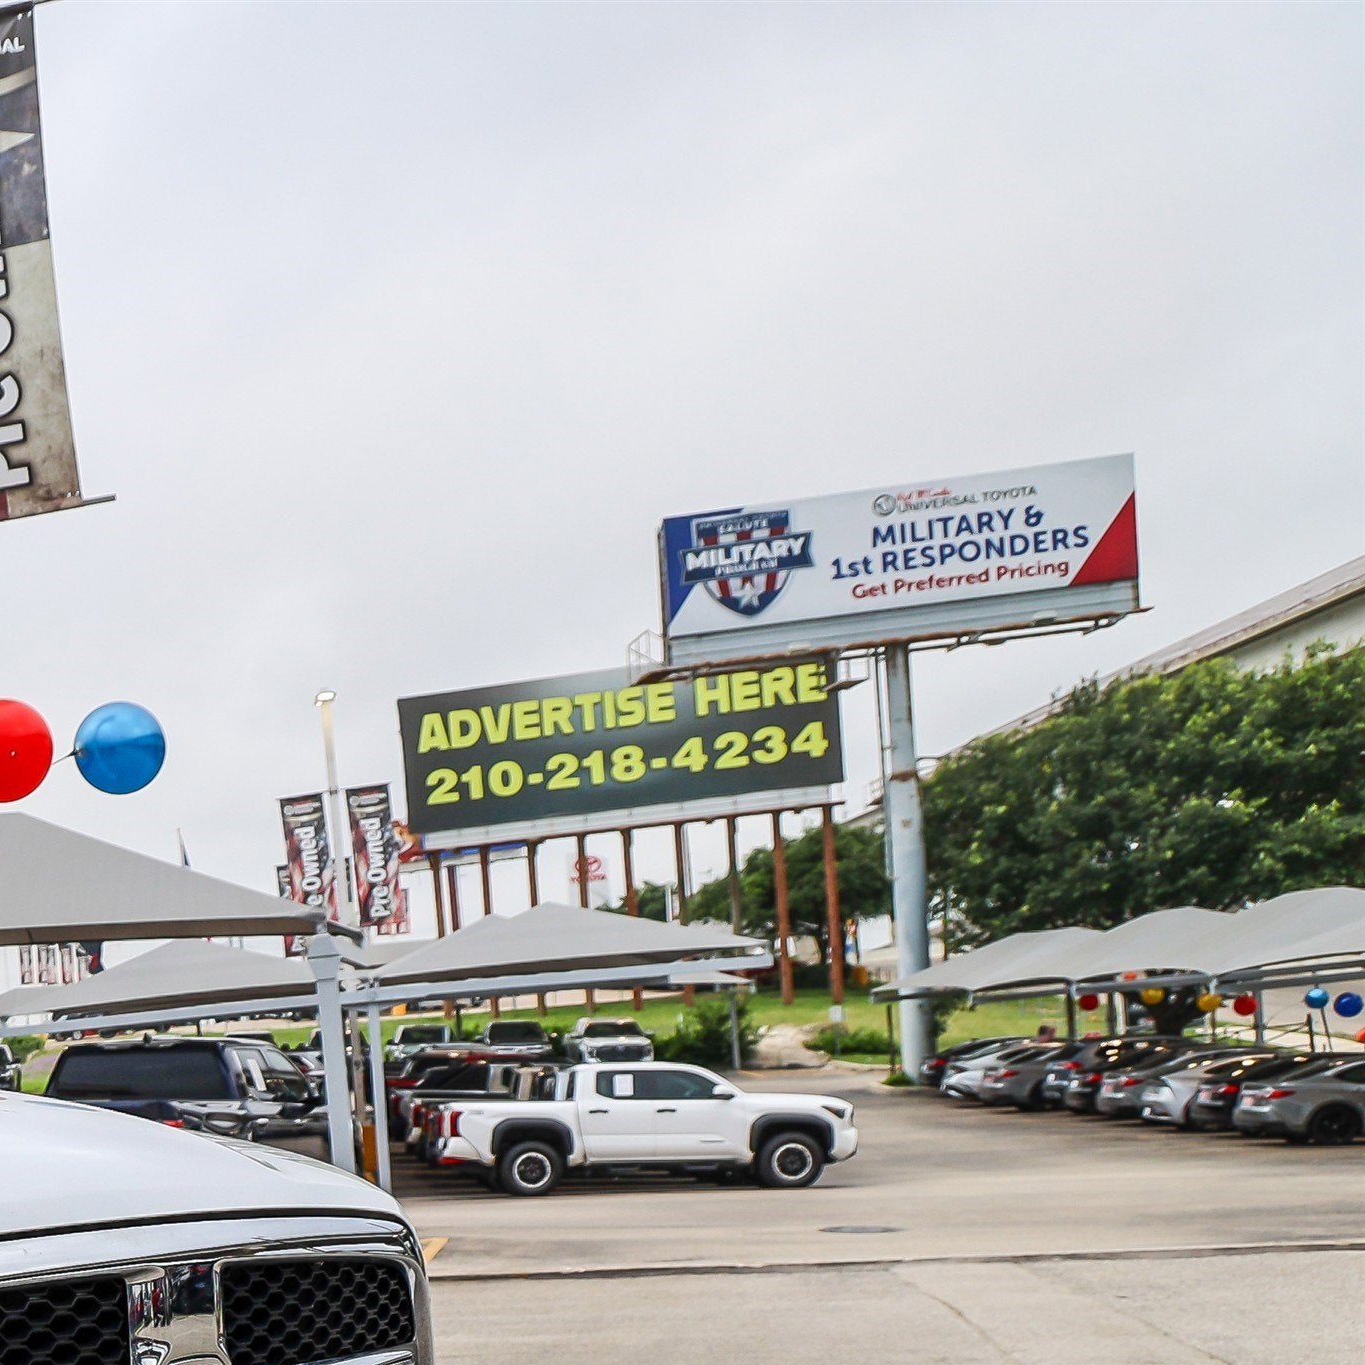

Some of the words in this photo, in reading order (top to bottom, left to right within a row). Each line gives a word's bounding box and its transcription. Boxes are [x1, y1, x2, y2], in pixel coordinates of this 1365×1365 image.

[982, 485, 1038, 502] TOYOTA
[872, 507, 1015, 548] MILITARY
[1024, 504, 1045, 528] &
[685, 536, 806, 572] MILITARY
[831, 555, 873, 580] 1st
[881, 525, 1090, 573] RESPONDERS
[852, 580, 887, 600] Get
[893, 567, 989, 595] Preferred
[997, 560, 1069, 581] Pricing
[417, 682, 677, 754] ADVERTISE
[695, 661, 829, 718] HERE
[425, 720, 830, 806] 210-218-4234
